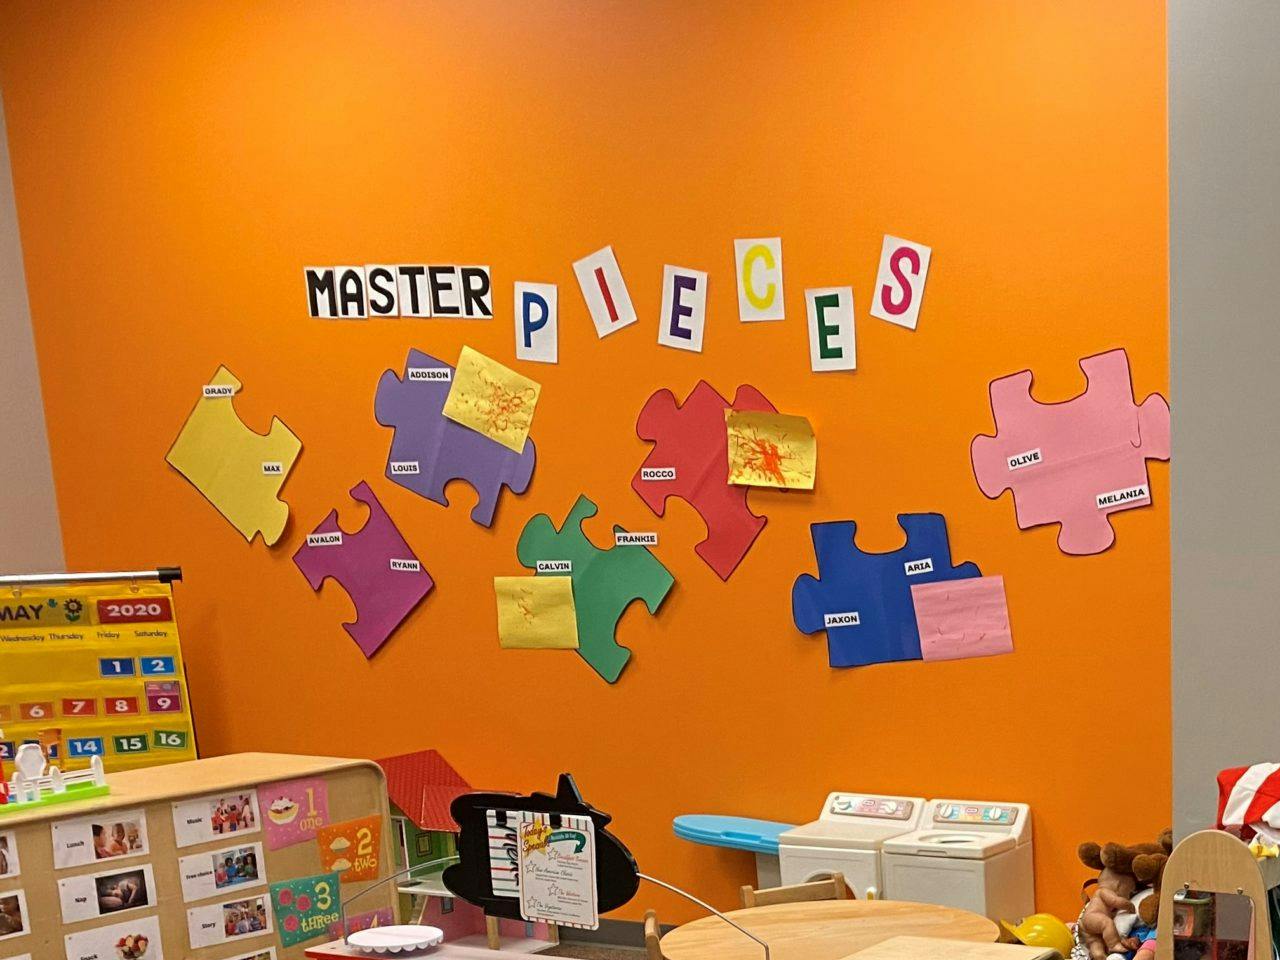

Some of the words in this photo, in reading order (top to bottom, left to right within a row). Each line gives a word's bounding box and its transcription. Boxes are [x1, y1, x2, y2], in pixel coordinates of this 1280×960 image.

[306, 266, 492, 317] MASTER
[410, 371, 449, 380] ADDISON
[1010, 453, 1040, 467] OLIVE
[263, 465, 281, 473] MAX
[392, 464, 418, 473] LOUIS
[643, 470, 674, 478] ROCCO
[1098, 487, 1145, 506] MELANIA
[308, 534, 341, 545] AVALON
[617, 534, 656, 544] FRANKIE
[391, 560, 419, 571] RYANN
[538, 561, 570, 571] CALVIN
[907, 562, 931, 573] ARIA
[106, 603, 162, 618] 2020
[826, 614, 858, 625] JAXON
[48, 632, 84, 641] Thursday
[96, 631, 120, 640] Friday
[134, 629, 168, 639] Saturday
[112, 660, 121, 673] 1
[151, 659, 165, 672] 2
[29, 705, 45, 718] 6
[72, 700, 86, 713] 7
[115, 699, 129, 712] 8
[157, 697, 172, 709] 9
[73, 740, 98, 753] 14
[119, 738, 143, 751] 15
[158, 733, 182, 746] 16
[306, 788, 318, 817] 1
[300, 816, 324, 832] one
[357, 828, 373, 856] 2
[315, 882, 331, 910] 3
